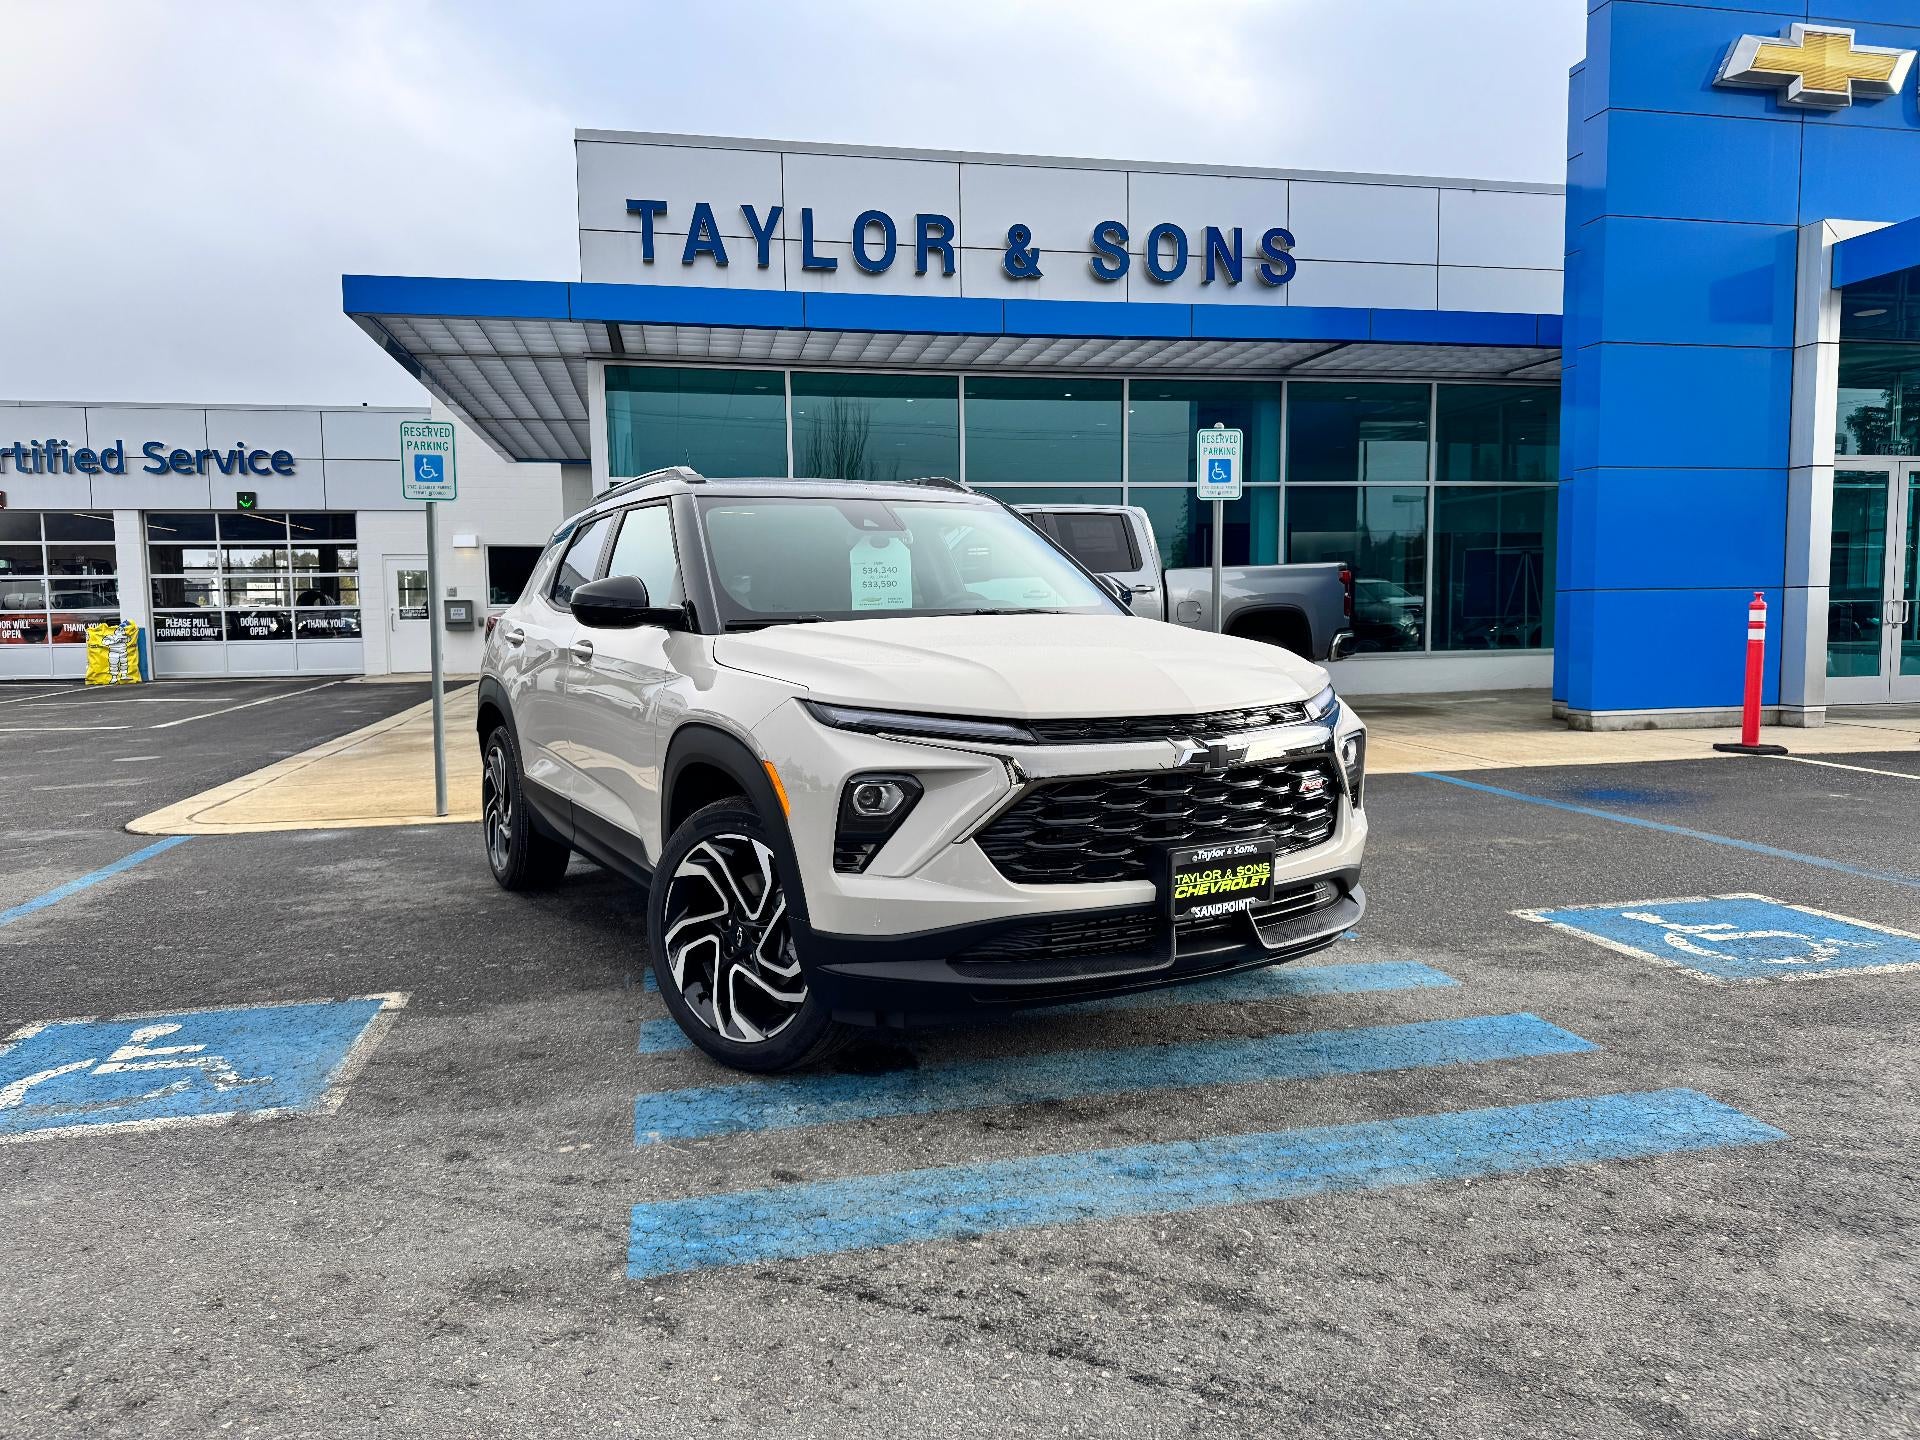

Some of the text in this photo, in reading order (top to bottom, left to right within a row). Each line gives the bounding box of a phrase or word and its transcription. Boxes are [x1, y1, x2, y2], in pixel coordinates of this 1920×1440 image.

[626, 199, 1297, 287] TAYLOR & SONS
[403, 426, 451, 438] RESERVED
[1201, 433, 1239, 444] RESERVED
[406, 440, 449, 452] PARKING
[1203, 446, 1237, 456] PARKING
[0, 438, 295, 476] rtified Service
[0, 620, 11, 629] OR
[12, 619, 30, 629] WILL
[165, 617, 210, 628] PLEASE PULL
[240, 617, 277, 627] DOOR WILL
[306, 618, 346, 629] THANK YOU!
[63, 623, 85, 633] THANK
[157, 628, 218, 637] FORWARD SLOWLY
[249, 626, 268, 636] OPEN
[2, 629, 21, 639] OPEN
[1197, 844, 1254, 861] Taylor & Sons
[1175, 862, 1270, 885] TAYLOR & SONS
[1174, 873, 1270, 899] CHEVROLET
[1194, 898, 1250, 918] SANDPOINT
